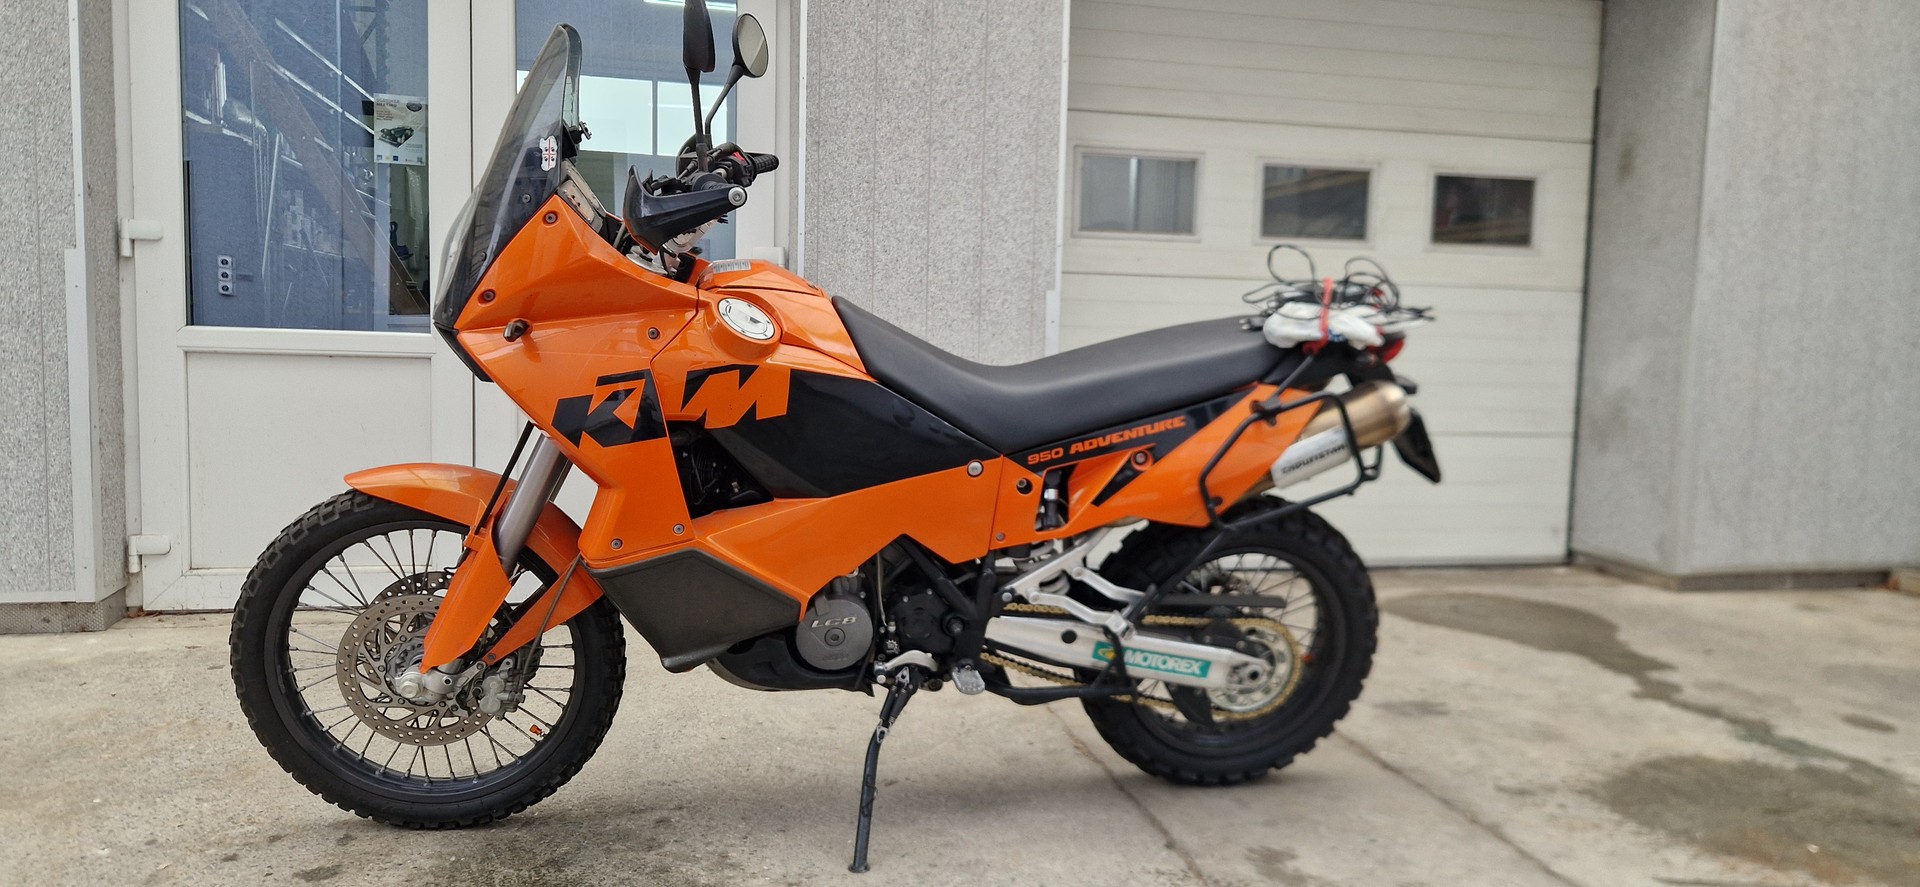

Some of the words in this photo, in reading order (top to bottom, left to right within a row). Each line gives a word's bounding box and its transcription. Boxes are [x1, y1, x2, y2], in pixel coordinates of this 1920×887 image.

[551, 364, 788, 449] KTM
[1028, 448, 1064, 465] 950
[1069, 415, 1186, 454] ADVENTURE
[811, 616, 857, 629] LC8
[1124, 649, 1204, 675] MOTOREX
